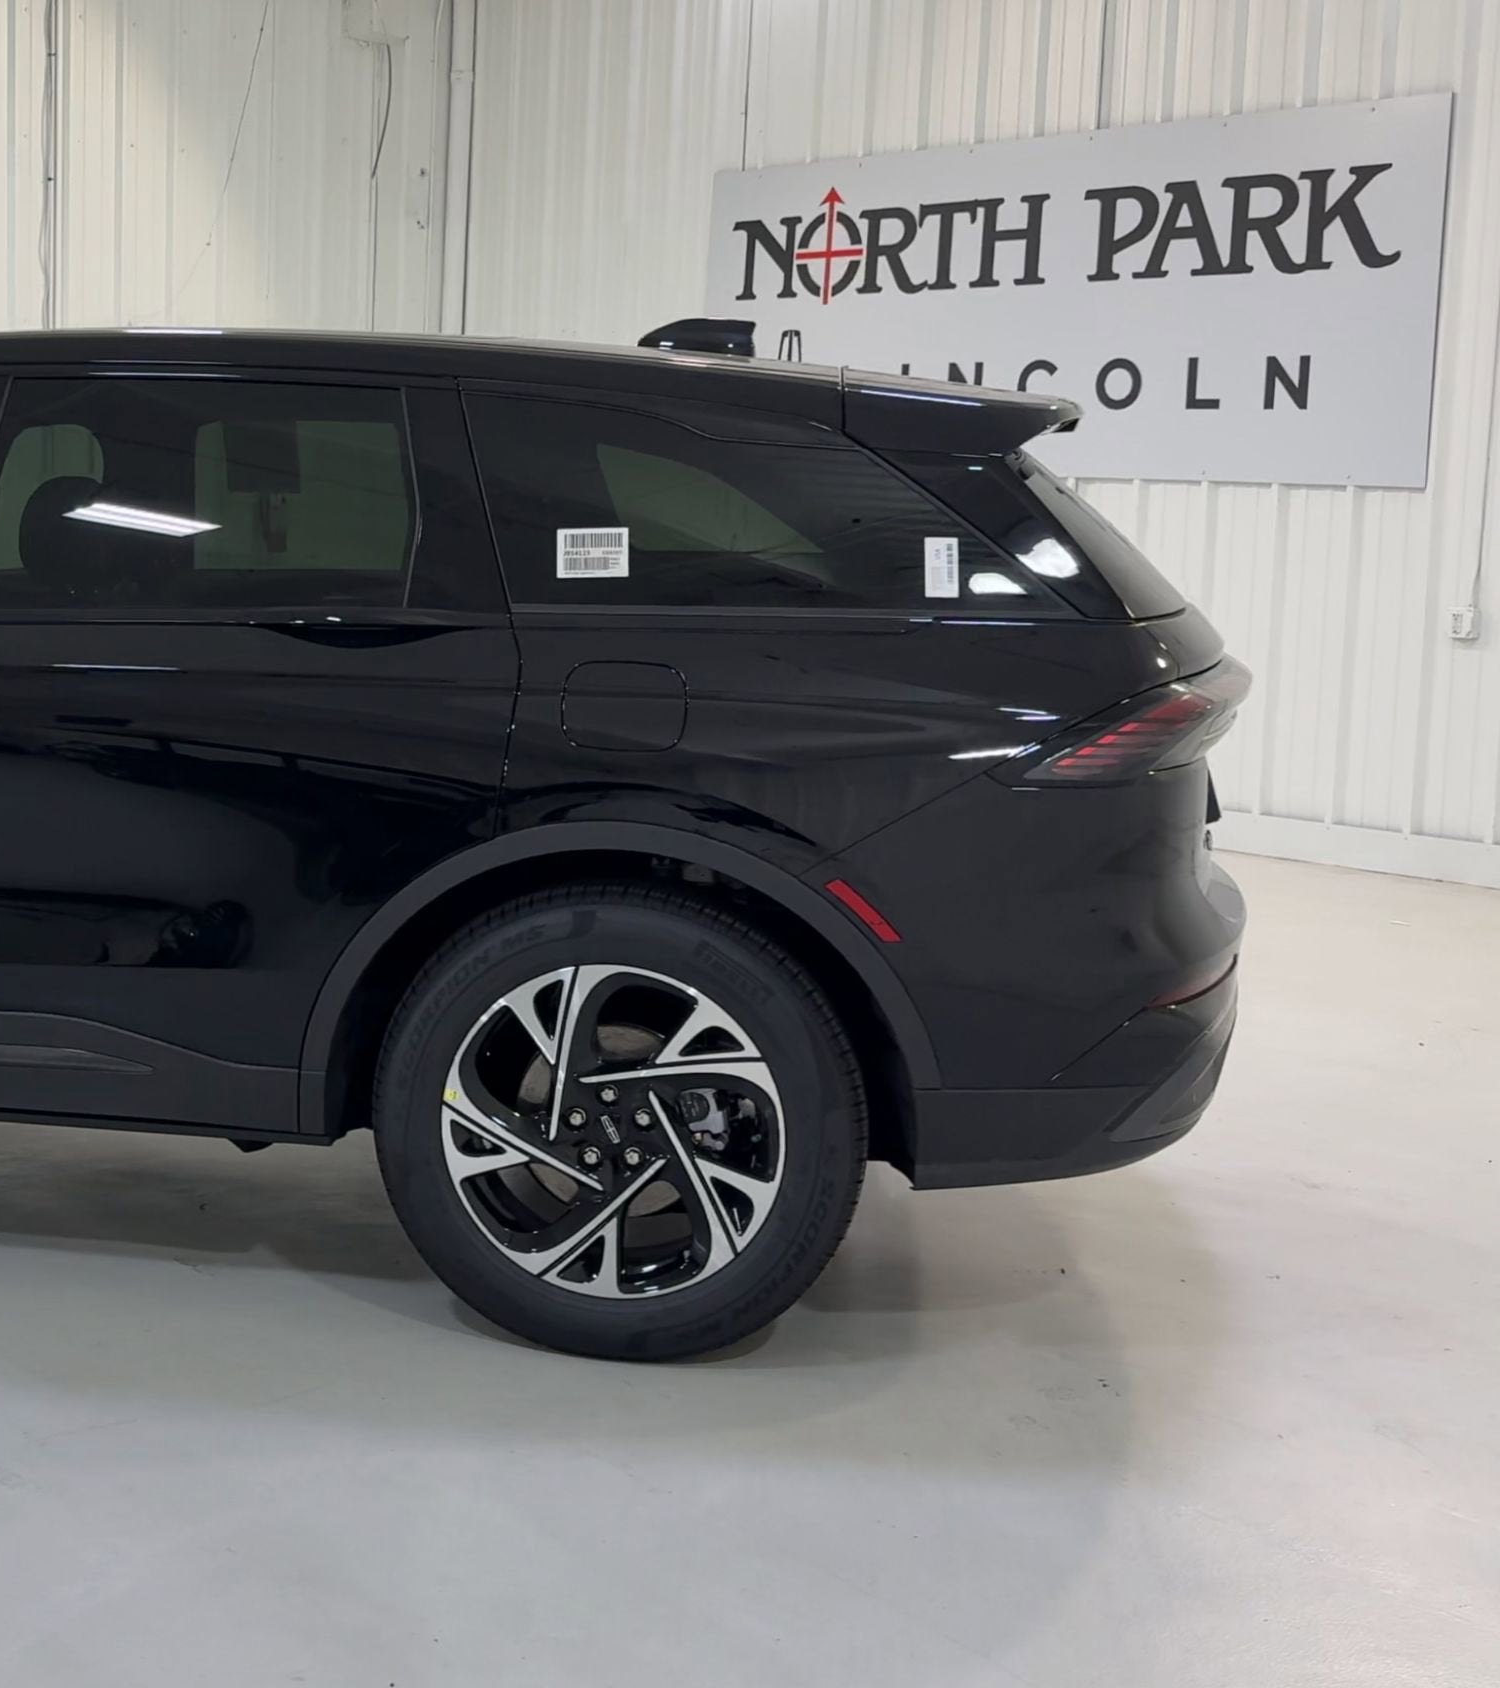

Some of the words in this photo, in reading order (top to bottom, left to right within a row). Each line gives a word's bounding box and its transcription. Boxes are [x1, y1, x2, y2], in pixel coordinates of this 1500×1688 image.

[733, 193, 1051, 302] NORTH
[1084, 162, 1402, 284] PARK
[902, 354, 1312, 412] COLN
